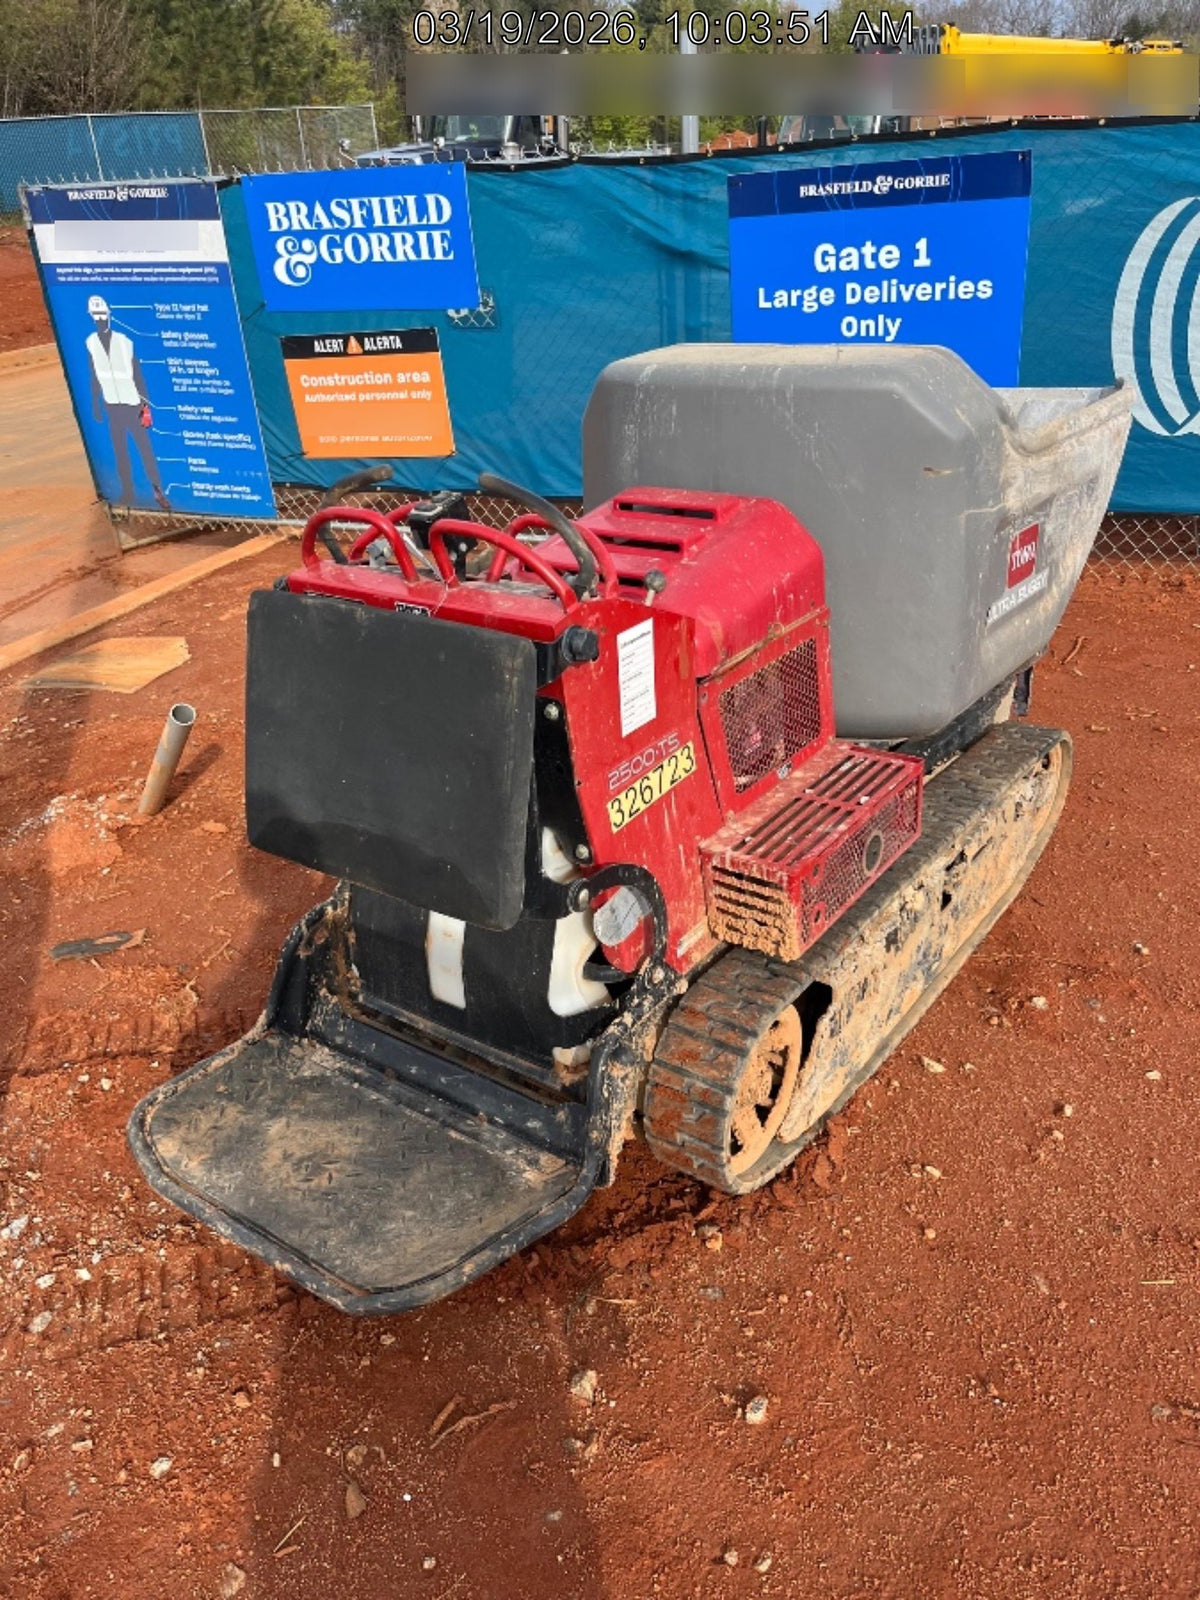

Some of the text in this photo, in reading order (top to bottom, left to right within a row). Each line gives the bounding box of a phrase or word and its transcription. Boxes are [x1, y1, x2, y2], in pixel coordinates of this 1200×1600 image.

[265, 194, 452, 232] BRASFIELD
[814, 237, 931, 273] Gate 1
[758, 275, 993, 313] Large Deliveries
[314, 335, 403, 354] ALERT ALERTA
[840, 314, 902, 342] Only
[300, 371, 431, 388] Construction area
[611, 745, 694, 829] 326723
